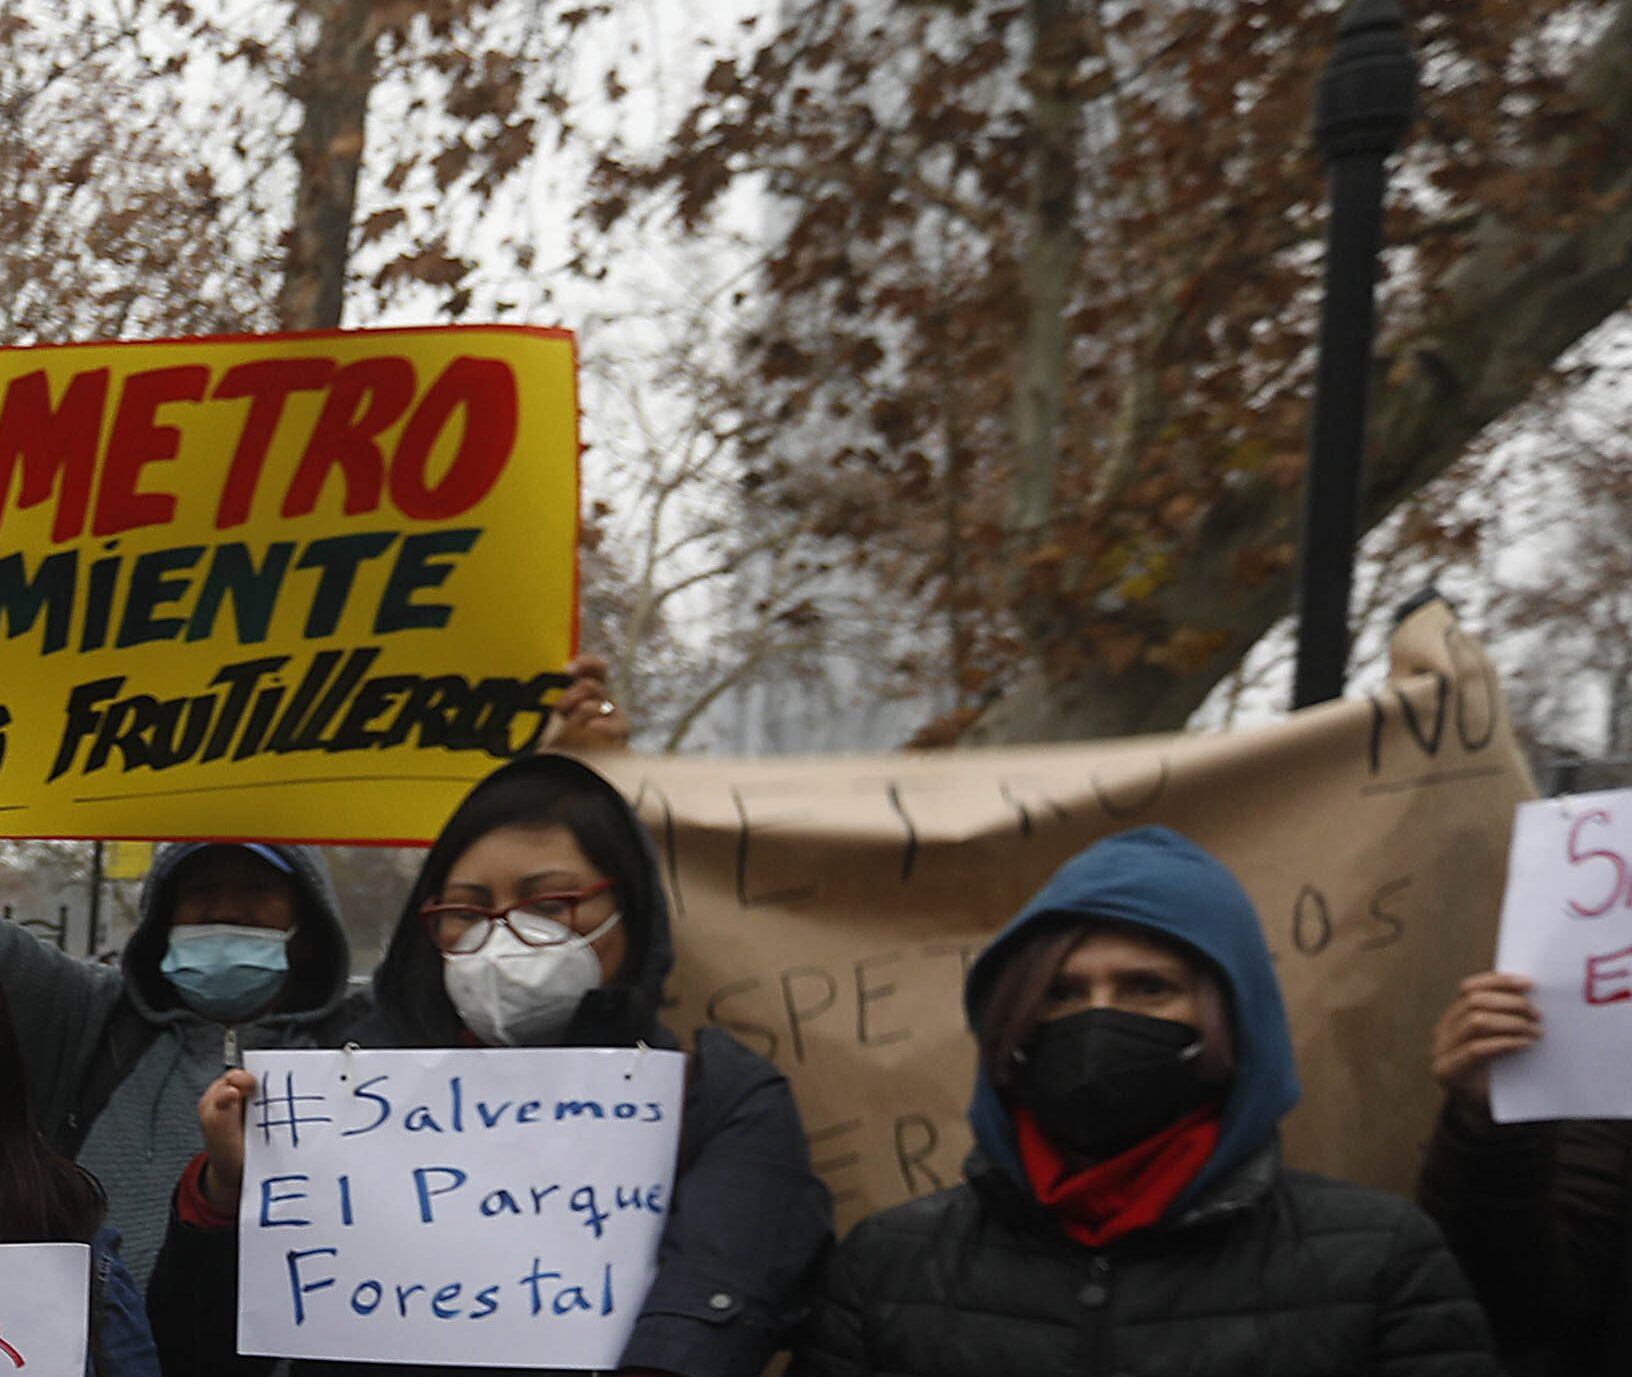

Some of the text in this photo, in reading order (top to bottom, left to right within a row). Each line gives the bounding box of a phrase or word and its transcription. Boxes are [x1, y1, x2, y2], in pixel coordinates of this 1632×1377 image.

[253, 1070, 665, 1148] #Salvemos
[259, 1166, 667, 1239] El Parque
[286, 1247, 614, 1327] Forestal
